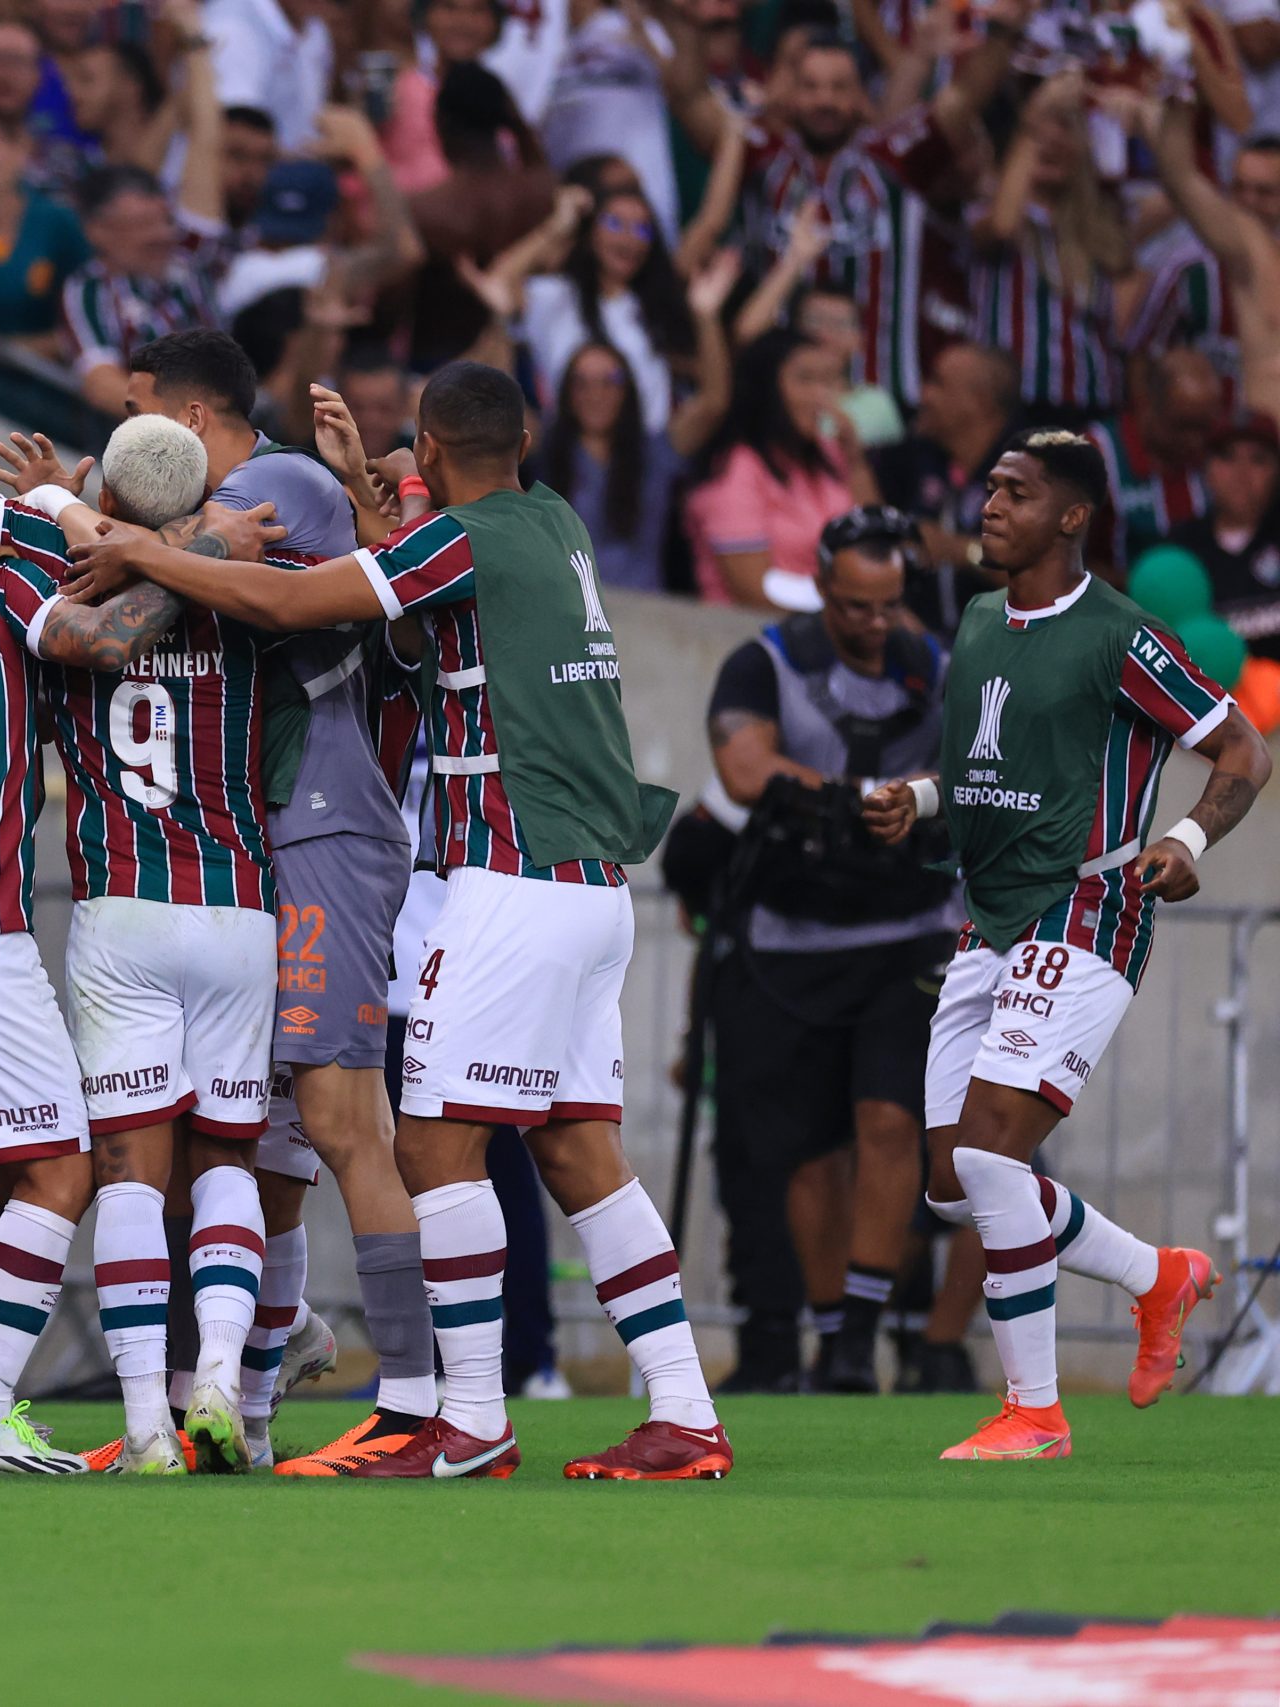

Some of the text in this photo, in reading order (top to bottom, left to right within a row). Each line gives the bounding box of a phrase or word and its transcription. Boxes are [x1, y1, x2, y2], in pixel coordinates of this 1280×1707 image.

[155, 705, 167, 730] TIM
[109, 680, 179, 809] 9
[278, 904, 326, 963] 22
[287, 967, 327, 992] HCI
[419, 948, 445, 1000] 4
[1012, 944, 1070, 990] 38
[1011, 991, 1054, 1018] HCI
[283, 1025, 317, 1035] umbro
[998, 1044, 1030, 1059] umbro
[127, 1082, 168, 1098] RECOVERY
[518, 1089, 556, 1098] RECOVERY
[12, 1121, 59, 1133] RECOVERY
[202, 1250, 241, 1258] FFC
